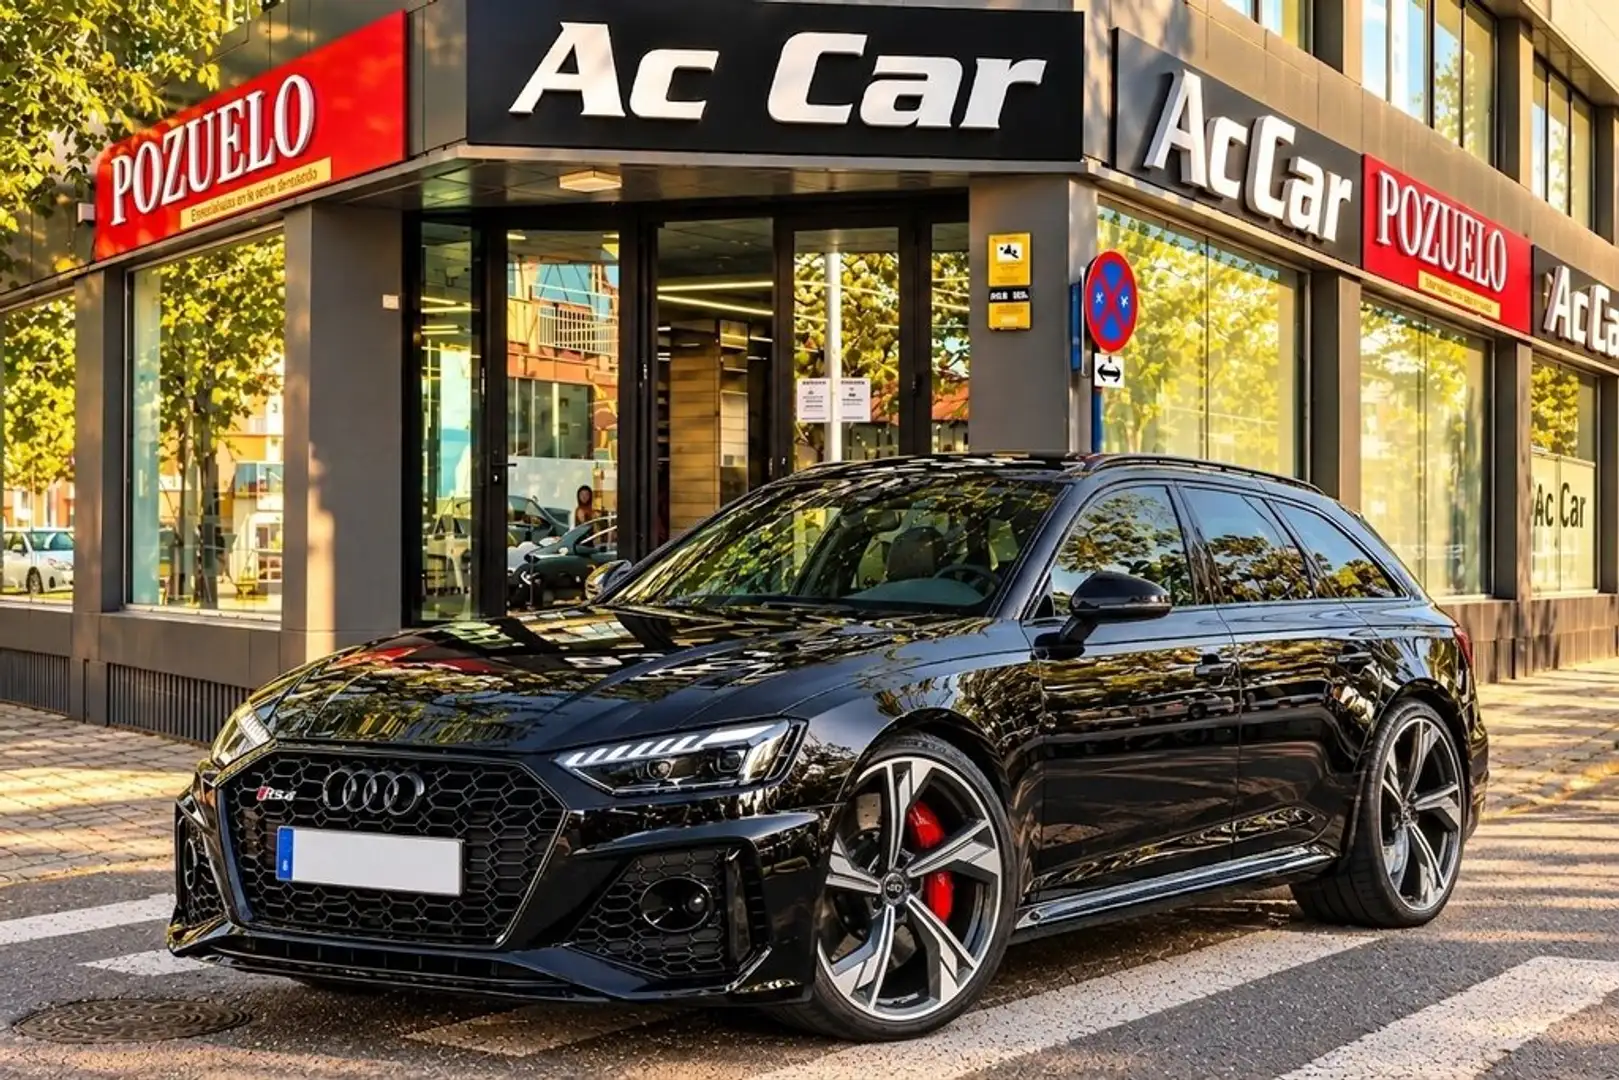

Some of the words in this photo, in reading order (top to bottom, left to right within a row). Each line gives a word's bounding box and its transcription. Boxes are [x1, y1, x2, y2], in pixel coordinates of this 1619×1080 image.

[508, 21, 720, 119] Ac
[768, 32, 1048, 129] Car
[110, 73, 316, 226] POZUELO
[1376, 170, 1507, 293] POZUELO
[1534, 483, 1554, 527] Ac
[1560, 482, 1586, 529] Car
